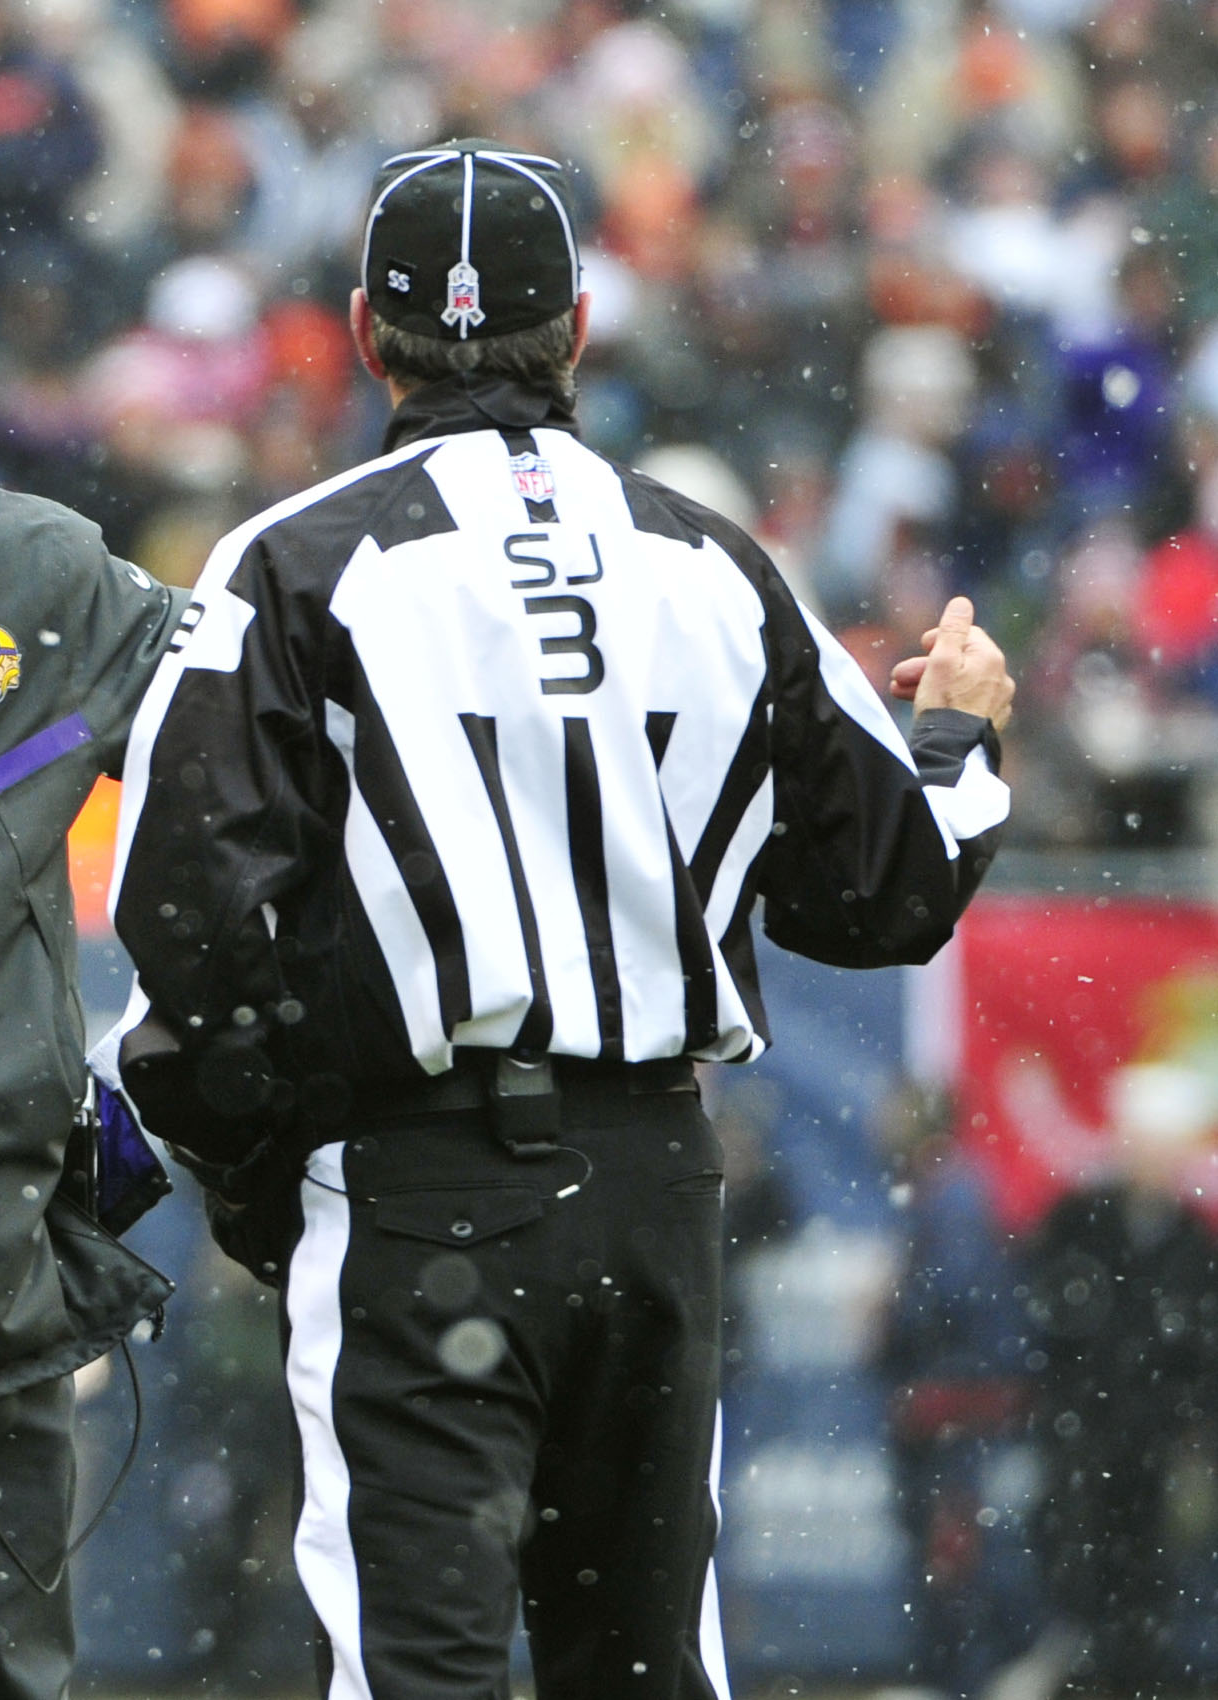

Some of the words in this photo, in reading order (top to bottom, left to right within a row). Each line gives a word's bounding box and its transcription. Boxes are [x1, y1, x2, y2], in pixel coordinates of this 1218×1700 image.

[514, 471, 555, 496] NFL
[503, 532, 603, 589] SJ
[524, 594, 605, 695] 3
